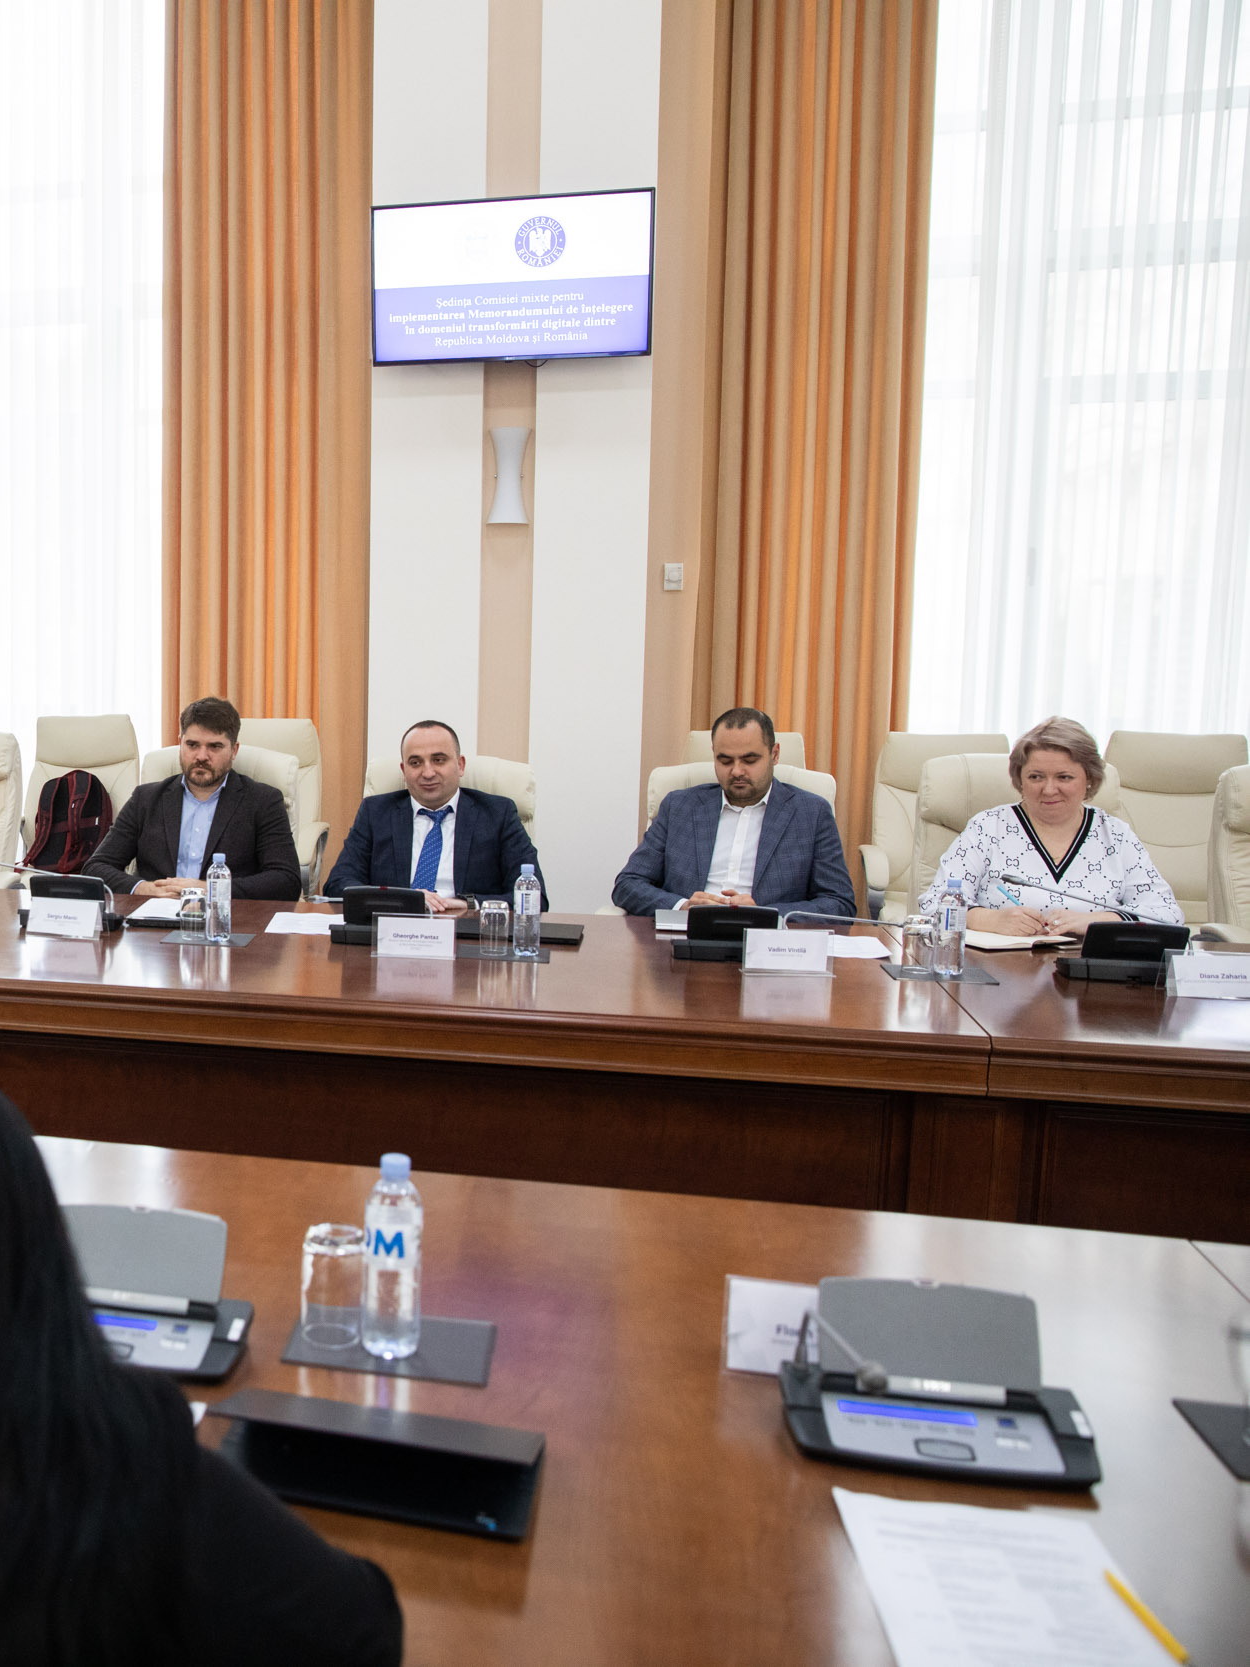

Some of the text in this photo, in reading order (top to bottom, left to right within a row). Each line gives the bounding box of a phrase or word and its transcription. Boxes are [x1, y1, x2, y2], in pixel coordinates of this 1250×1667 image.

[518, 217, 563, 237] GUVERNUL
[475, 293, 518, 305] Comisiei
[521, 293, 550, 303] mixte
[552, 292, 584, 304] pentru
[389, 311, 465, 324] implementarea
[468, 305, 563, 319] Memorandumului
[566, 304, 578, 314] de
[405, 317, 617, 335] în domeniul transformării digitale dintre
[435, 335, 483, 348] Republica
[486, 333, 530, 345] Moldova
[543, 331, 588, 342] România
[392, 932, 419, 940] Gheorghe
[366, 1226, 405, 1259] M
